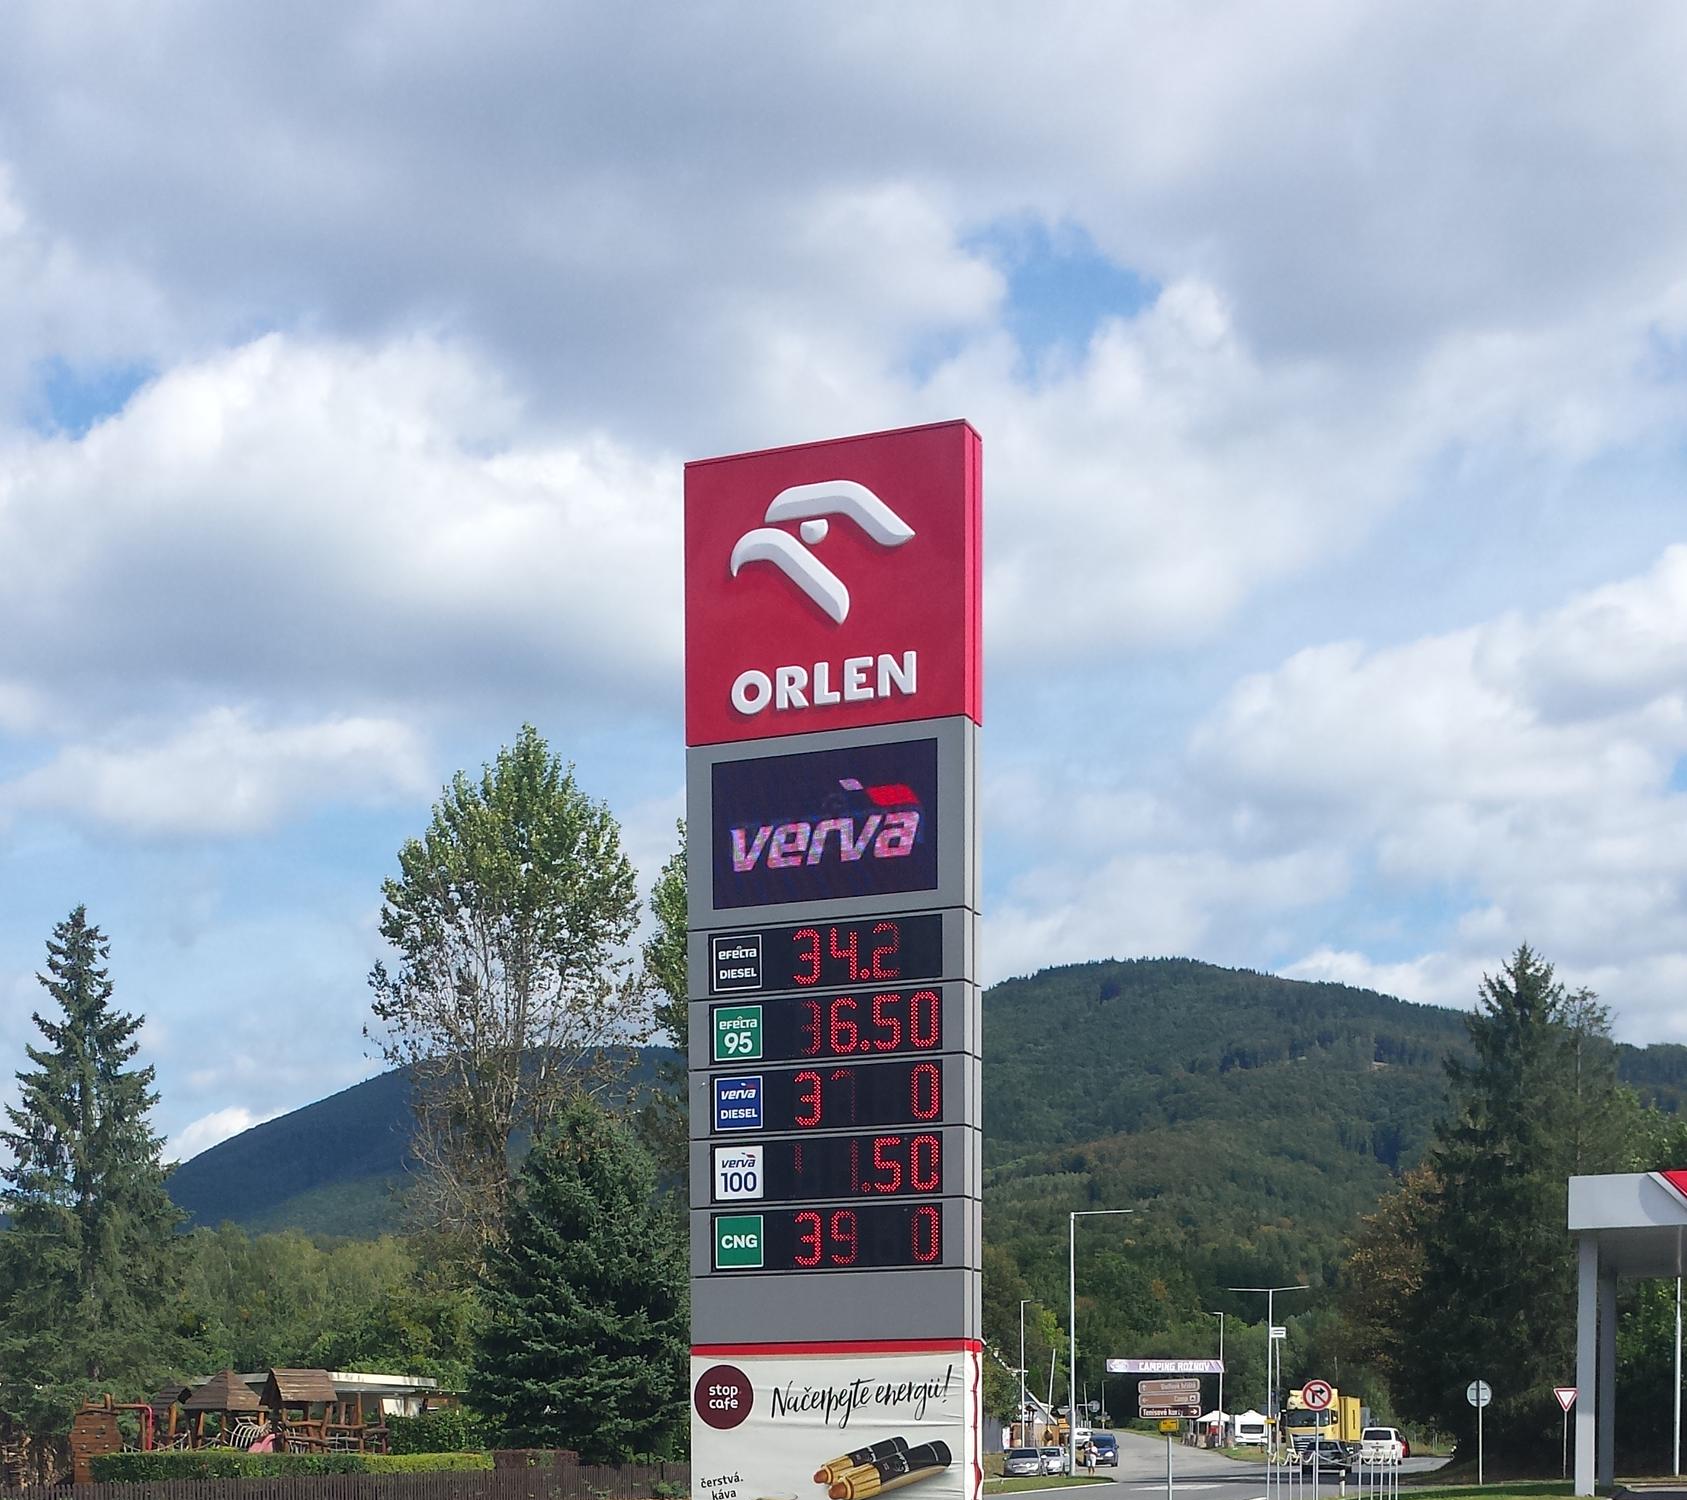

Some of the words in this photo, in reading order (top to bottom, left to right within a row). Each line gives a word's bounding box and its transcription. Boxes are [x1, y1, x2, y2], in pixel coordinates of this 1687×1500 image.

[730, 650, 917, 716] ORLEN
[730, 811, 920, 873] verva
[719, 968, 757, 980] DIESEL
[724, 1032, 753, 1054] 95
[721, 1089, 756, 1100] verva
[720, 1108, 758, 1120] DIESEL
[721, 1159, 756, 1168] verva
[720, 1171, 757, 1192] 100
[721, 1234, 758, 1249] CNG
[1138, 1361, 1176, 1371] CAMPING
[709, 1384, 739, 1399] stop
[709, 1397, 739, 1411] cafe
[771, 1378, 876, 1429] Načerpejte
